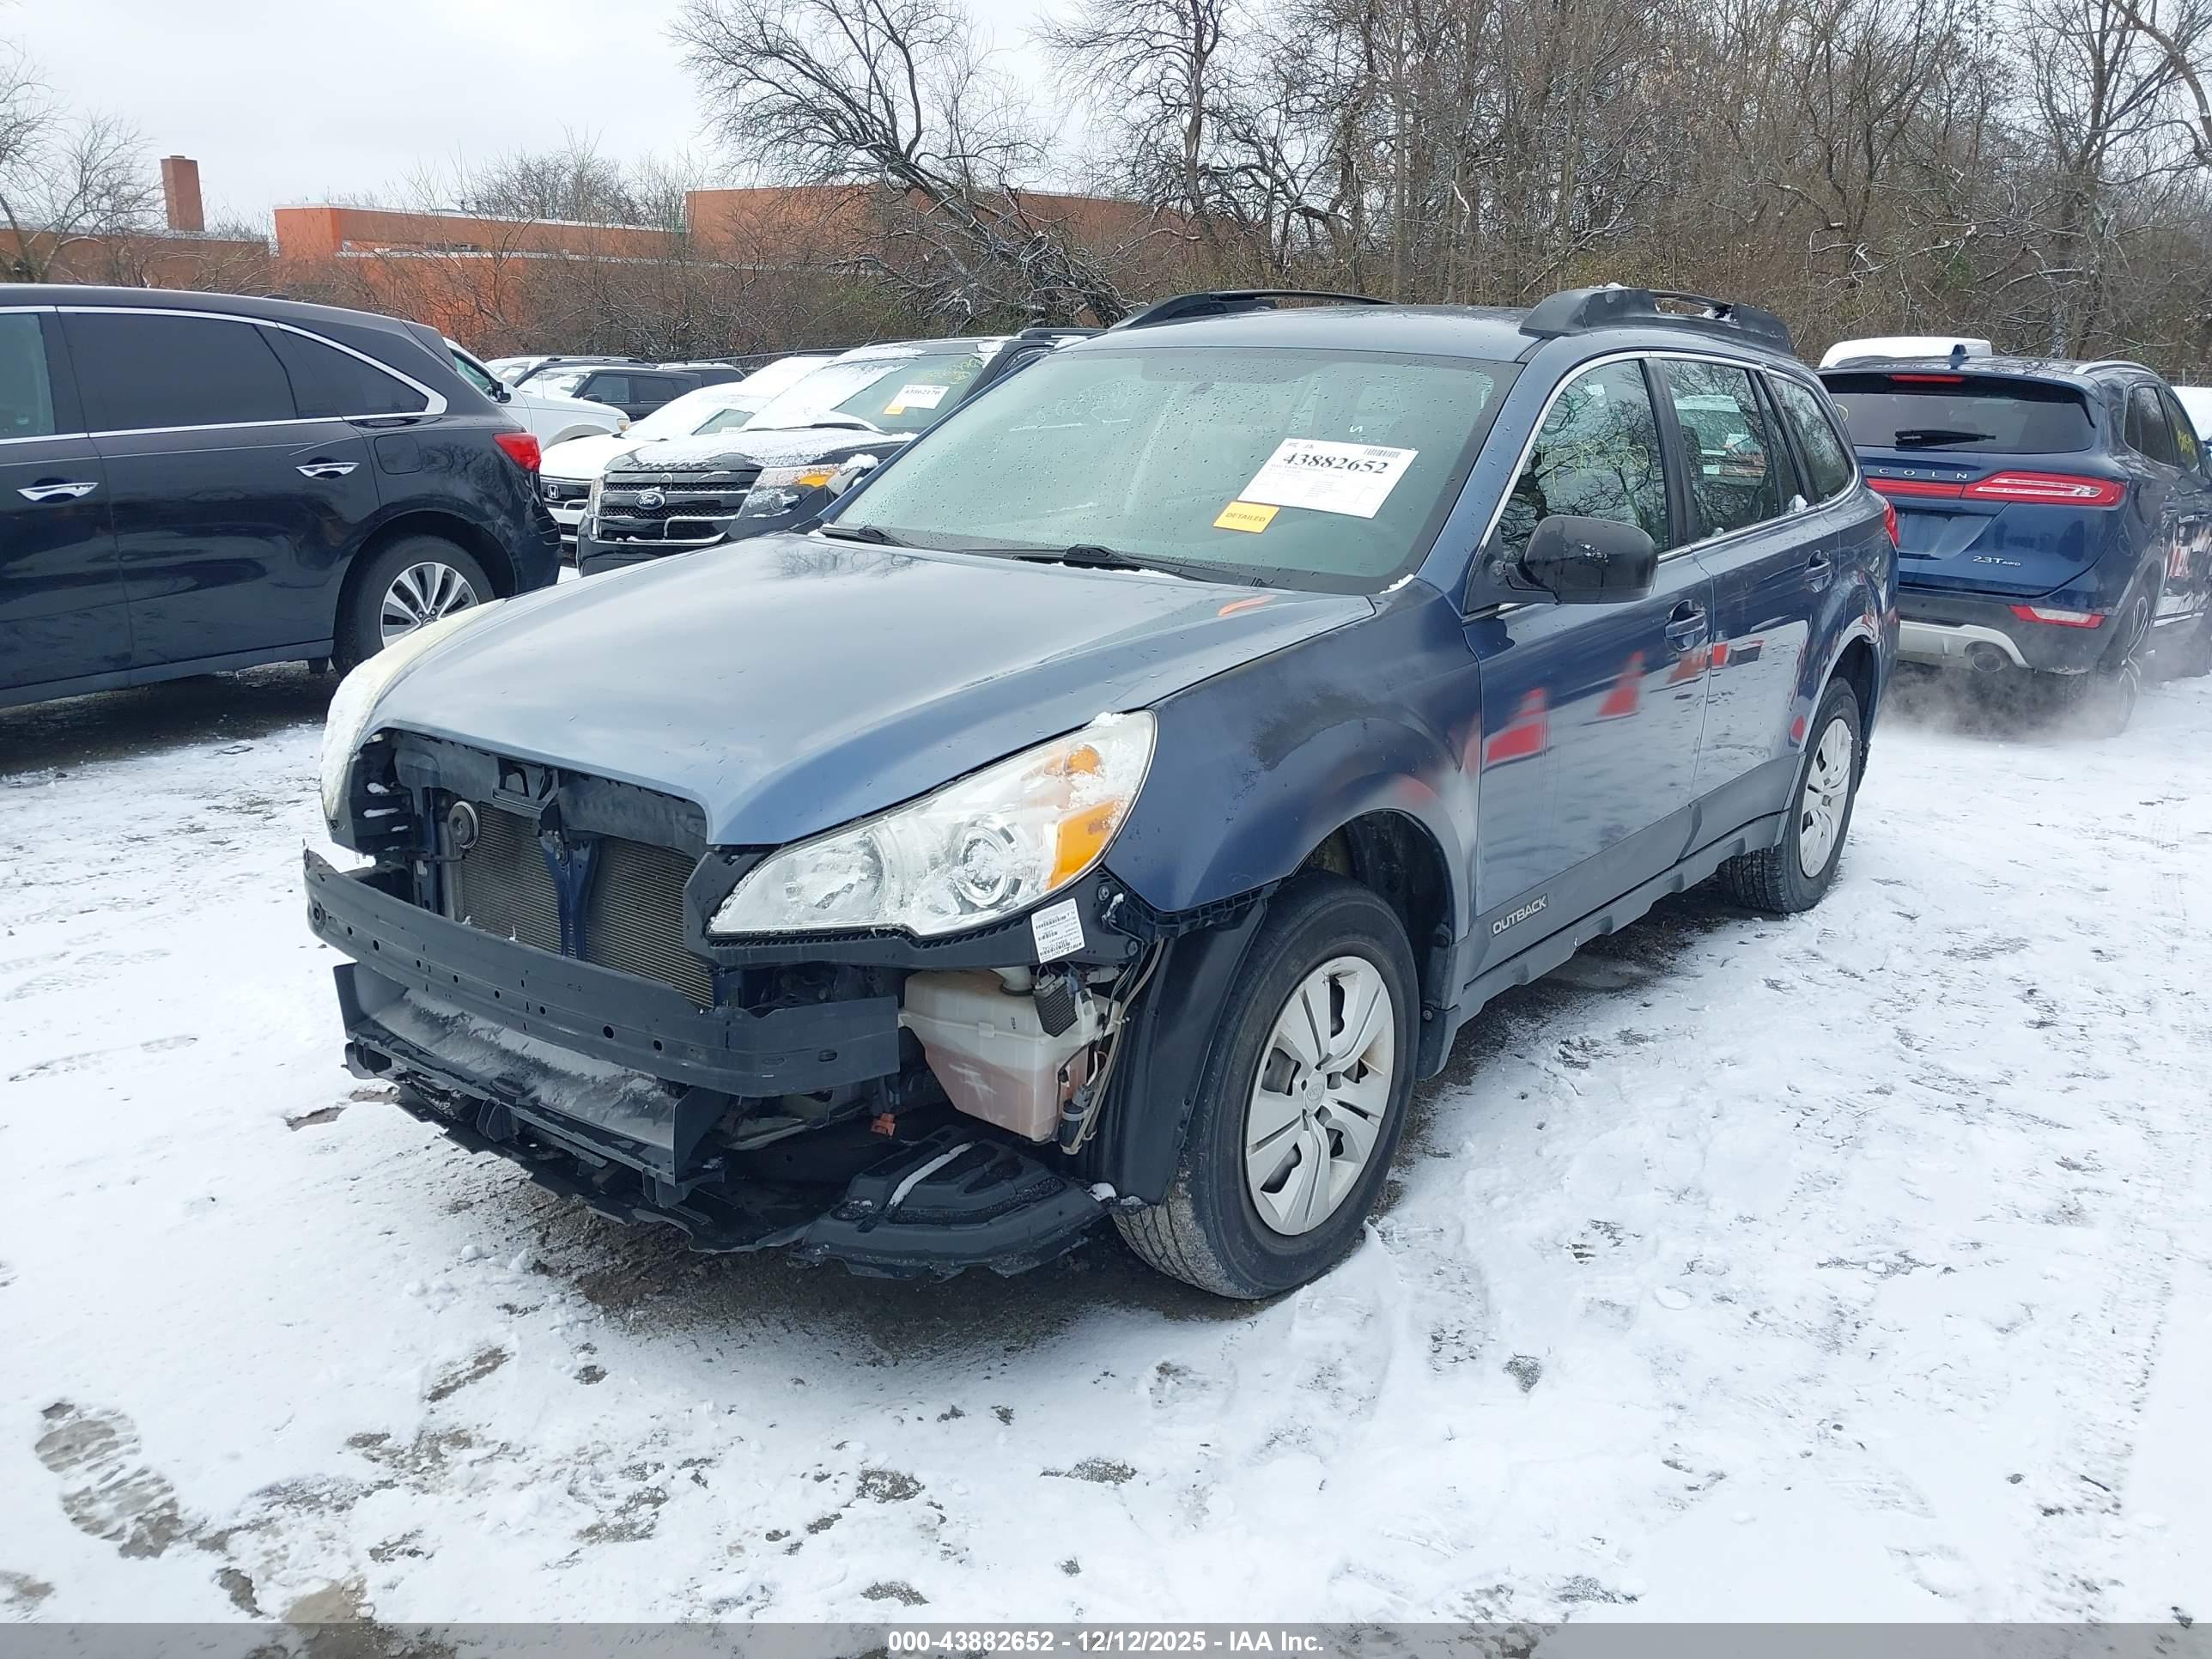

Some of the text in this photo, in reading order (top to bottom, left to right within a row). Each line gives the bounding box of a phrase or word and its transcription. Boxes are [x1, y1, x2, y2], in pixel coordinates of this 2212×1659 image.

[1283, 453, 1389, 474] 43882652
[639, 494, 657, 505] Ford
[1226, 512, 1267, 523] DETAILED
[1492, 895, 1547, 935] OUTBACK
